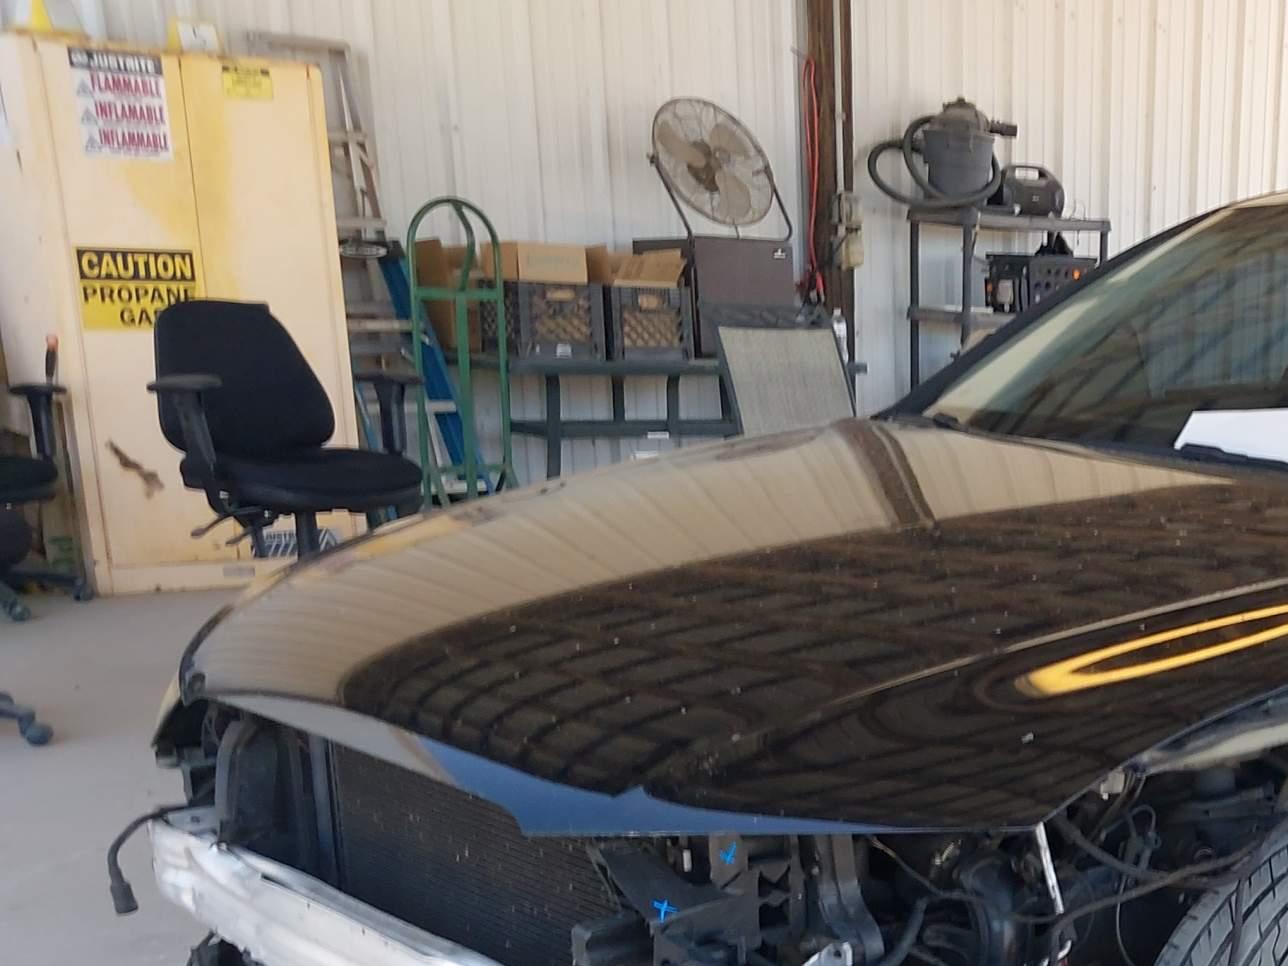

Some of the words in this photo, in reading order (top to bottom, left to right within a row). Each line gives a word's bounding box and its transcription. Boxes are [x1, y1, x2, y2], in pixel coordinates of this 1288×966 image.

[90, 71, 162, 97] FLAMMABLE
[81, 251, 193, 280] CAUTION
[119, 307, 156, 327] GA
